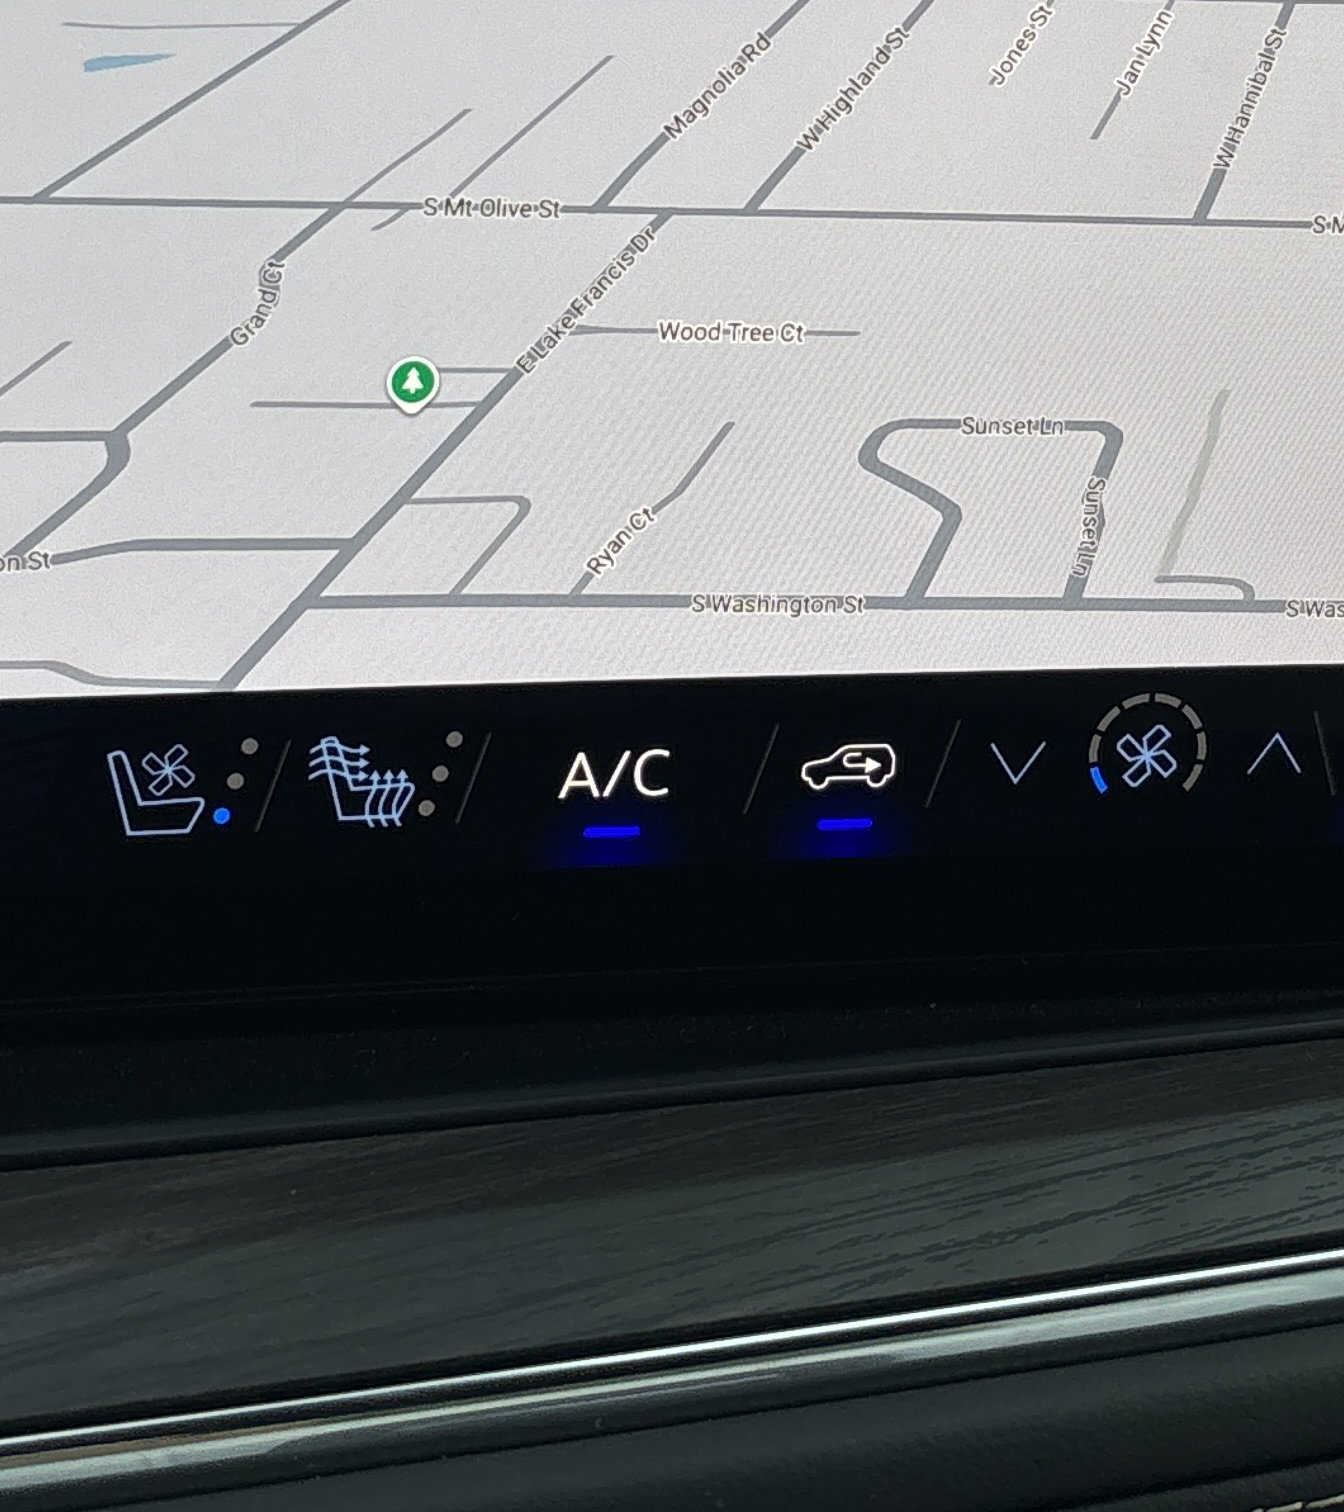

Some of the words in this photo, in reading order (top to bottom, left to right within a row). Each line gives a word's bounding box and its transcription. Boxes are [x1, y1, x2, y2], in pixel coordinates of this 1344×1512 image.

[991, 29, 1037, 85] Jones
[1030, 3, 1054, 27] St
[1114, 57, 1145, 97] Jan
[1138, 9, 1172, 58] Lynn
[662, 61, 747, 139] Magnolia
[741, 33, 772, 62] Rd
[797, 129, 819, 152] W
[816, 48, 892, 132] Highland
[885, 26, 910, 49] St
[1213, 147, 1235, 170] W
[1226, 51, 1277, 143] Hannibal
[1264, 25, 1286, 50] St
[423, 198, 439, 217] S
[444, 198, 473, 217] Mt
[480, 198, 532, 218] Olive
[538, 199, 559, 219] St
[1312, 216, 1326, 234] S
[228, 289, 279, 347] Grand
[259, 259, 286, 286] Ct
[516, 353, 536, 374] E
[531, 312, 576, 359] Lake
[570, 251, 635, 315] Francis
[630, 226, 658, 253] Dr
[658, 321, 722, 342] Wood
[728, 321, 775, 343] Tree
[780, 322, 806, 343] Ct
[961, 416, 1034, 436] Sunset
[1040, 417, 1064, 437] Ln
[1080, 477, 1106, 546] Sunset
[28, 552, 51, 571] St
[586, 529, 632, 578] Ryan
[628, 506, 656, 533] Ct
[1072, 551, 1090, 577] Ln
[692, 595, 706, 613] S
[711, 594, 838, 617] Washington
[844, 596, 864, 614] St
[1287, 600, 1299, 618] S
[558, 749, 670, 801] A/C
